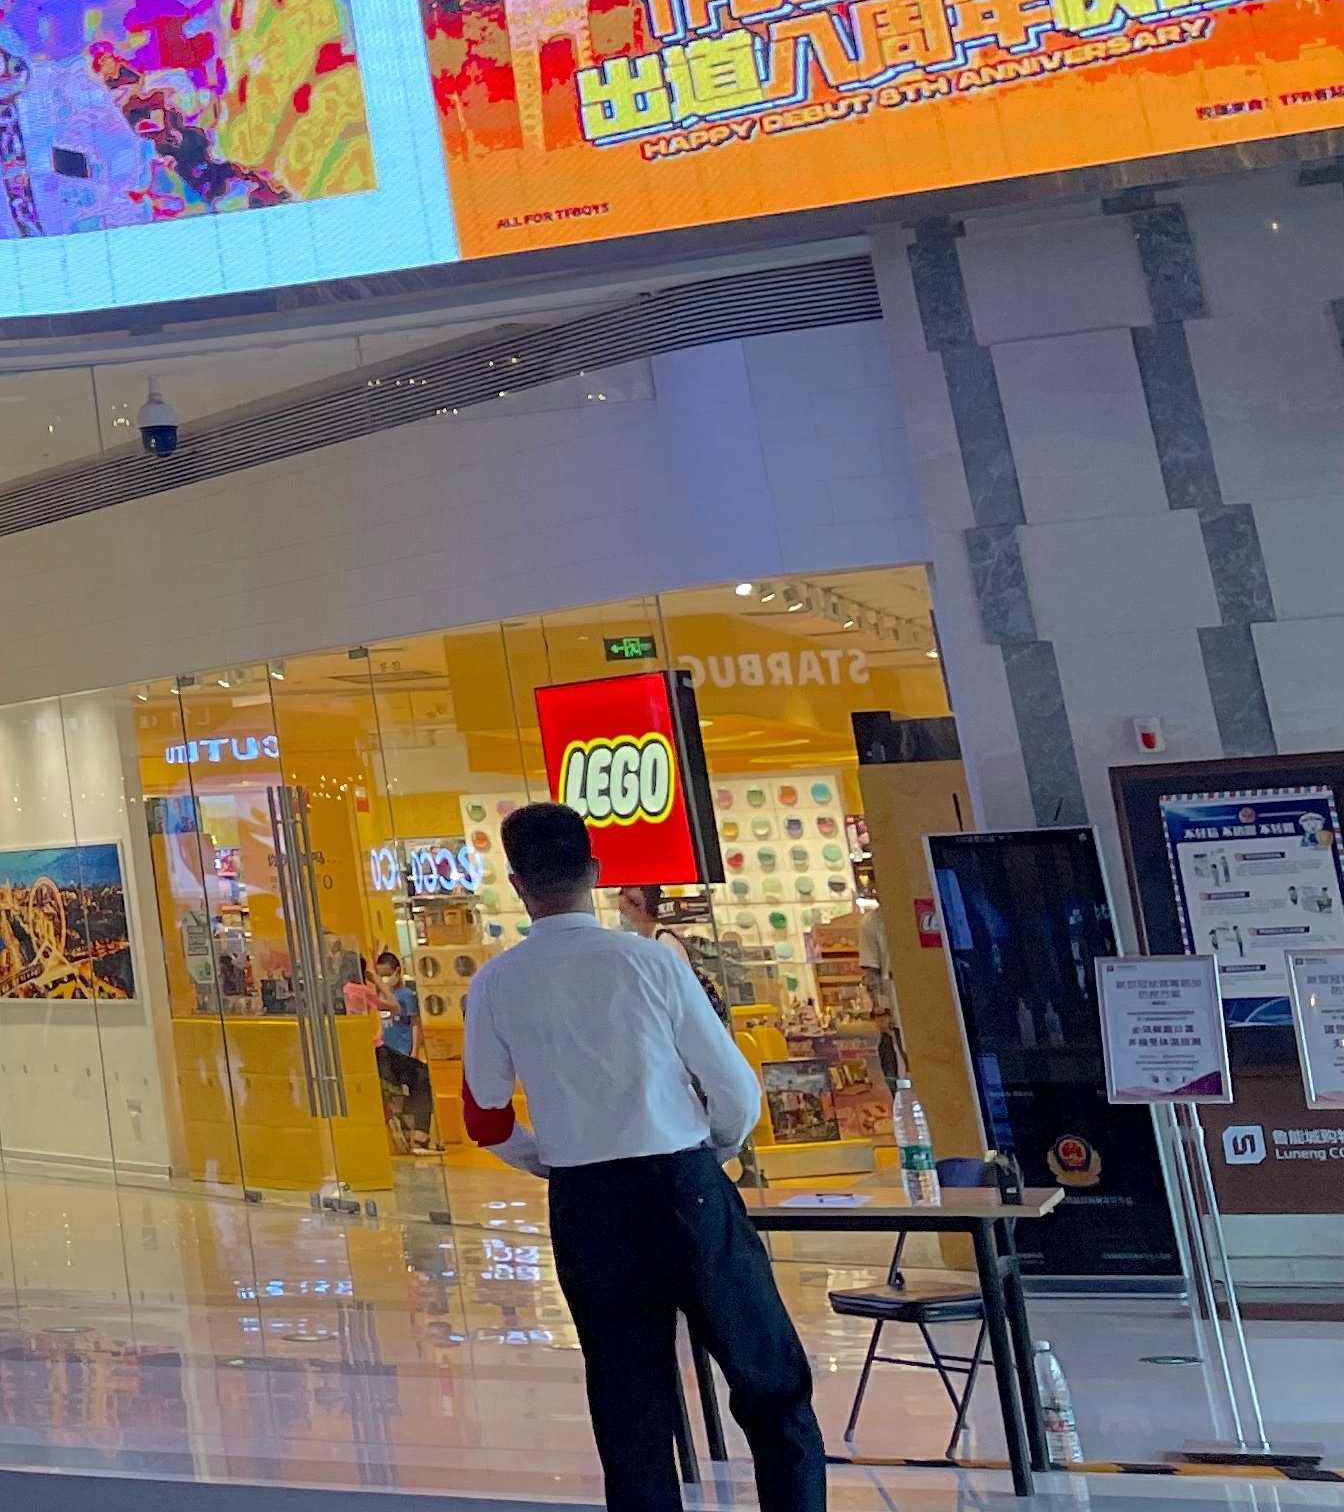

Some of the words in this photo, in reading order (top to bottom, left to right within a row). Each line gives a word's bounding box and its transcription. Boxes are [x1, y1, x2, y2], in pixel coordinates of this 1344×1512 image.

[641, 117, 757, 161] HAPPY
[763, 94, 873, 133] DEBUT
[876, 77, 953, 108] 8TH
[957, 17, 1215, 91] ANNIVERSARY
[524, 211, 553, 225] FOR
[565, 740, 670, 819] LEGO
[1275, 1147, 1327, 1161] Luneng
